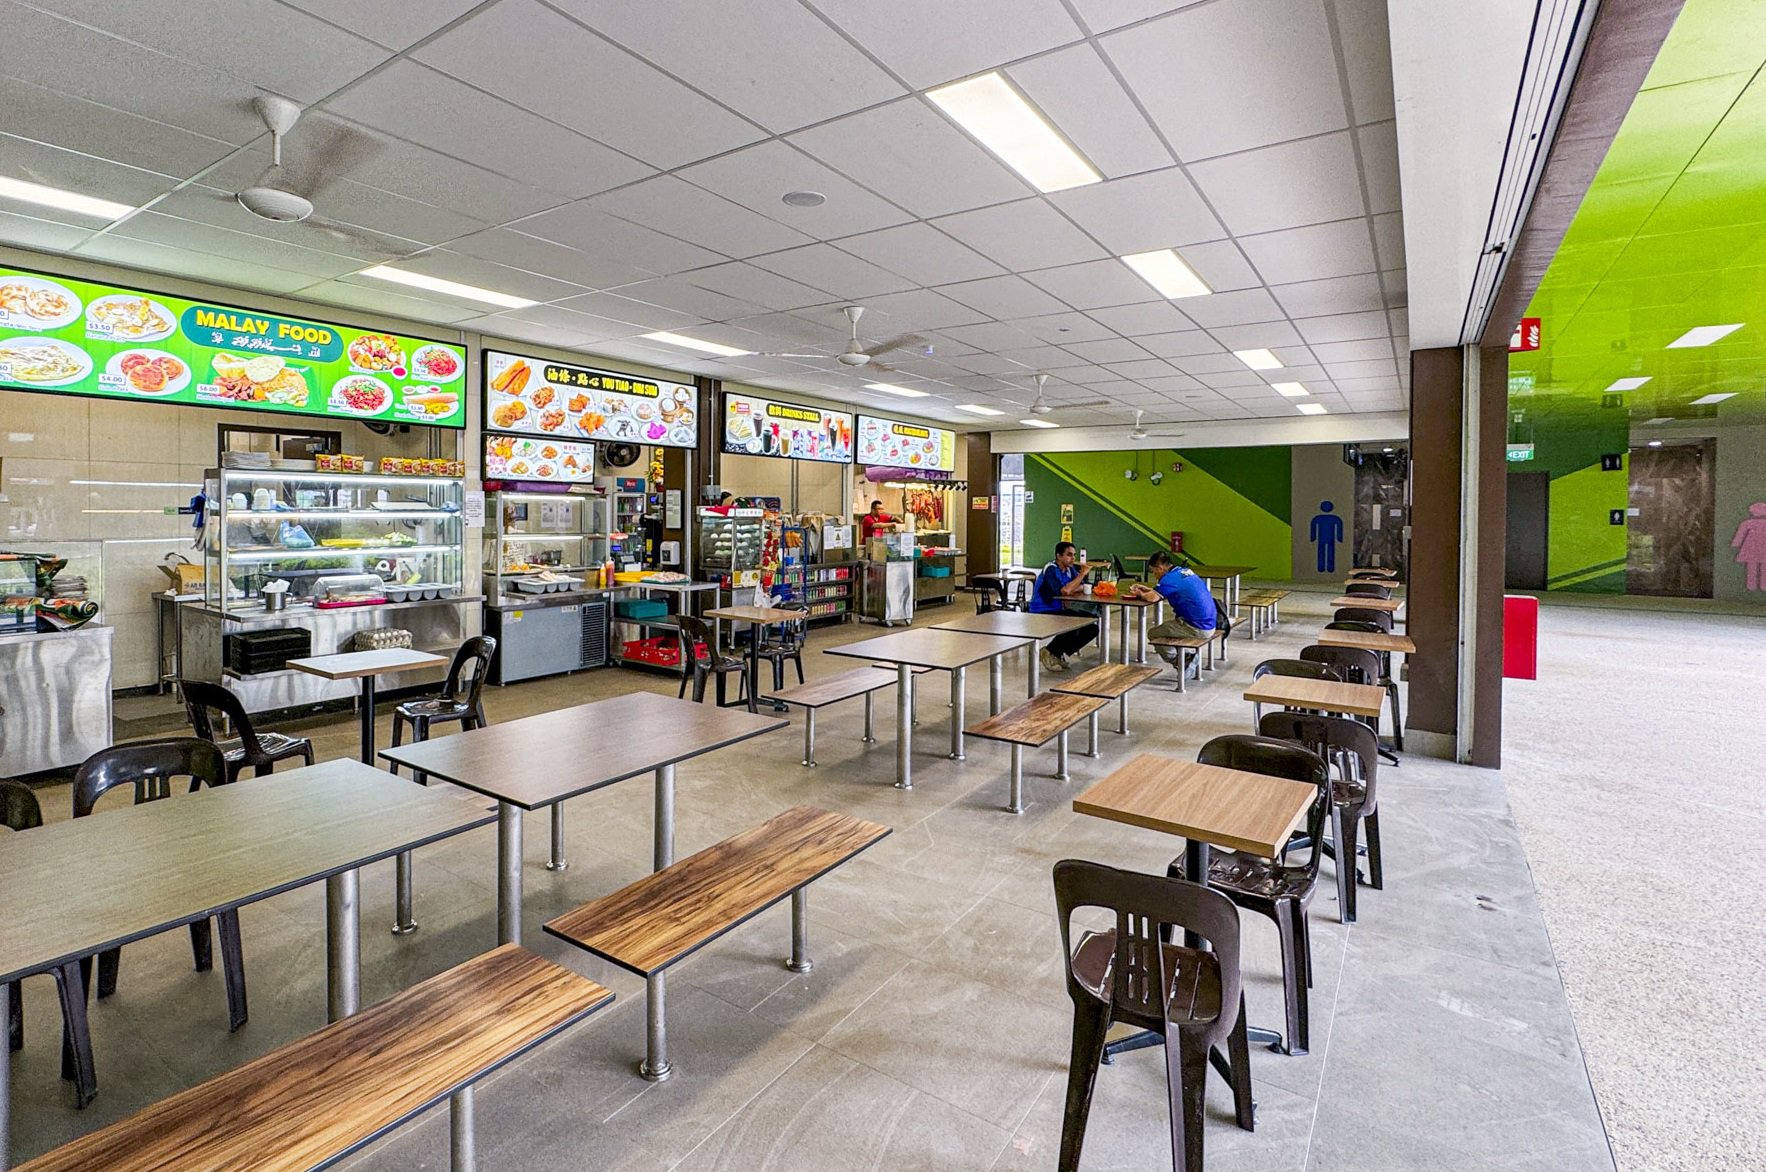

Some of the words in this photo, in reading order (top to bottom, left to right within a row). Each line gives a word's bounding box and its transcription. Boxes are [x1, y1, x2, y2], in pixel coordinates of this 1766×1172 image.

[196, 310, 270, 336] MALAY
[279, 323, 332, 345] FOOD
[602, 377, 615, 389] YOU
[645, 385, 658, 396] SUM
[1513, 450, 1530, 458] EXIT
